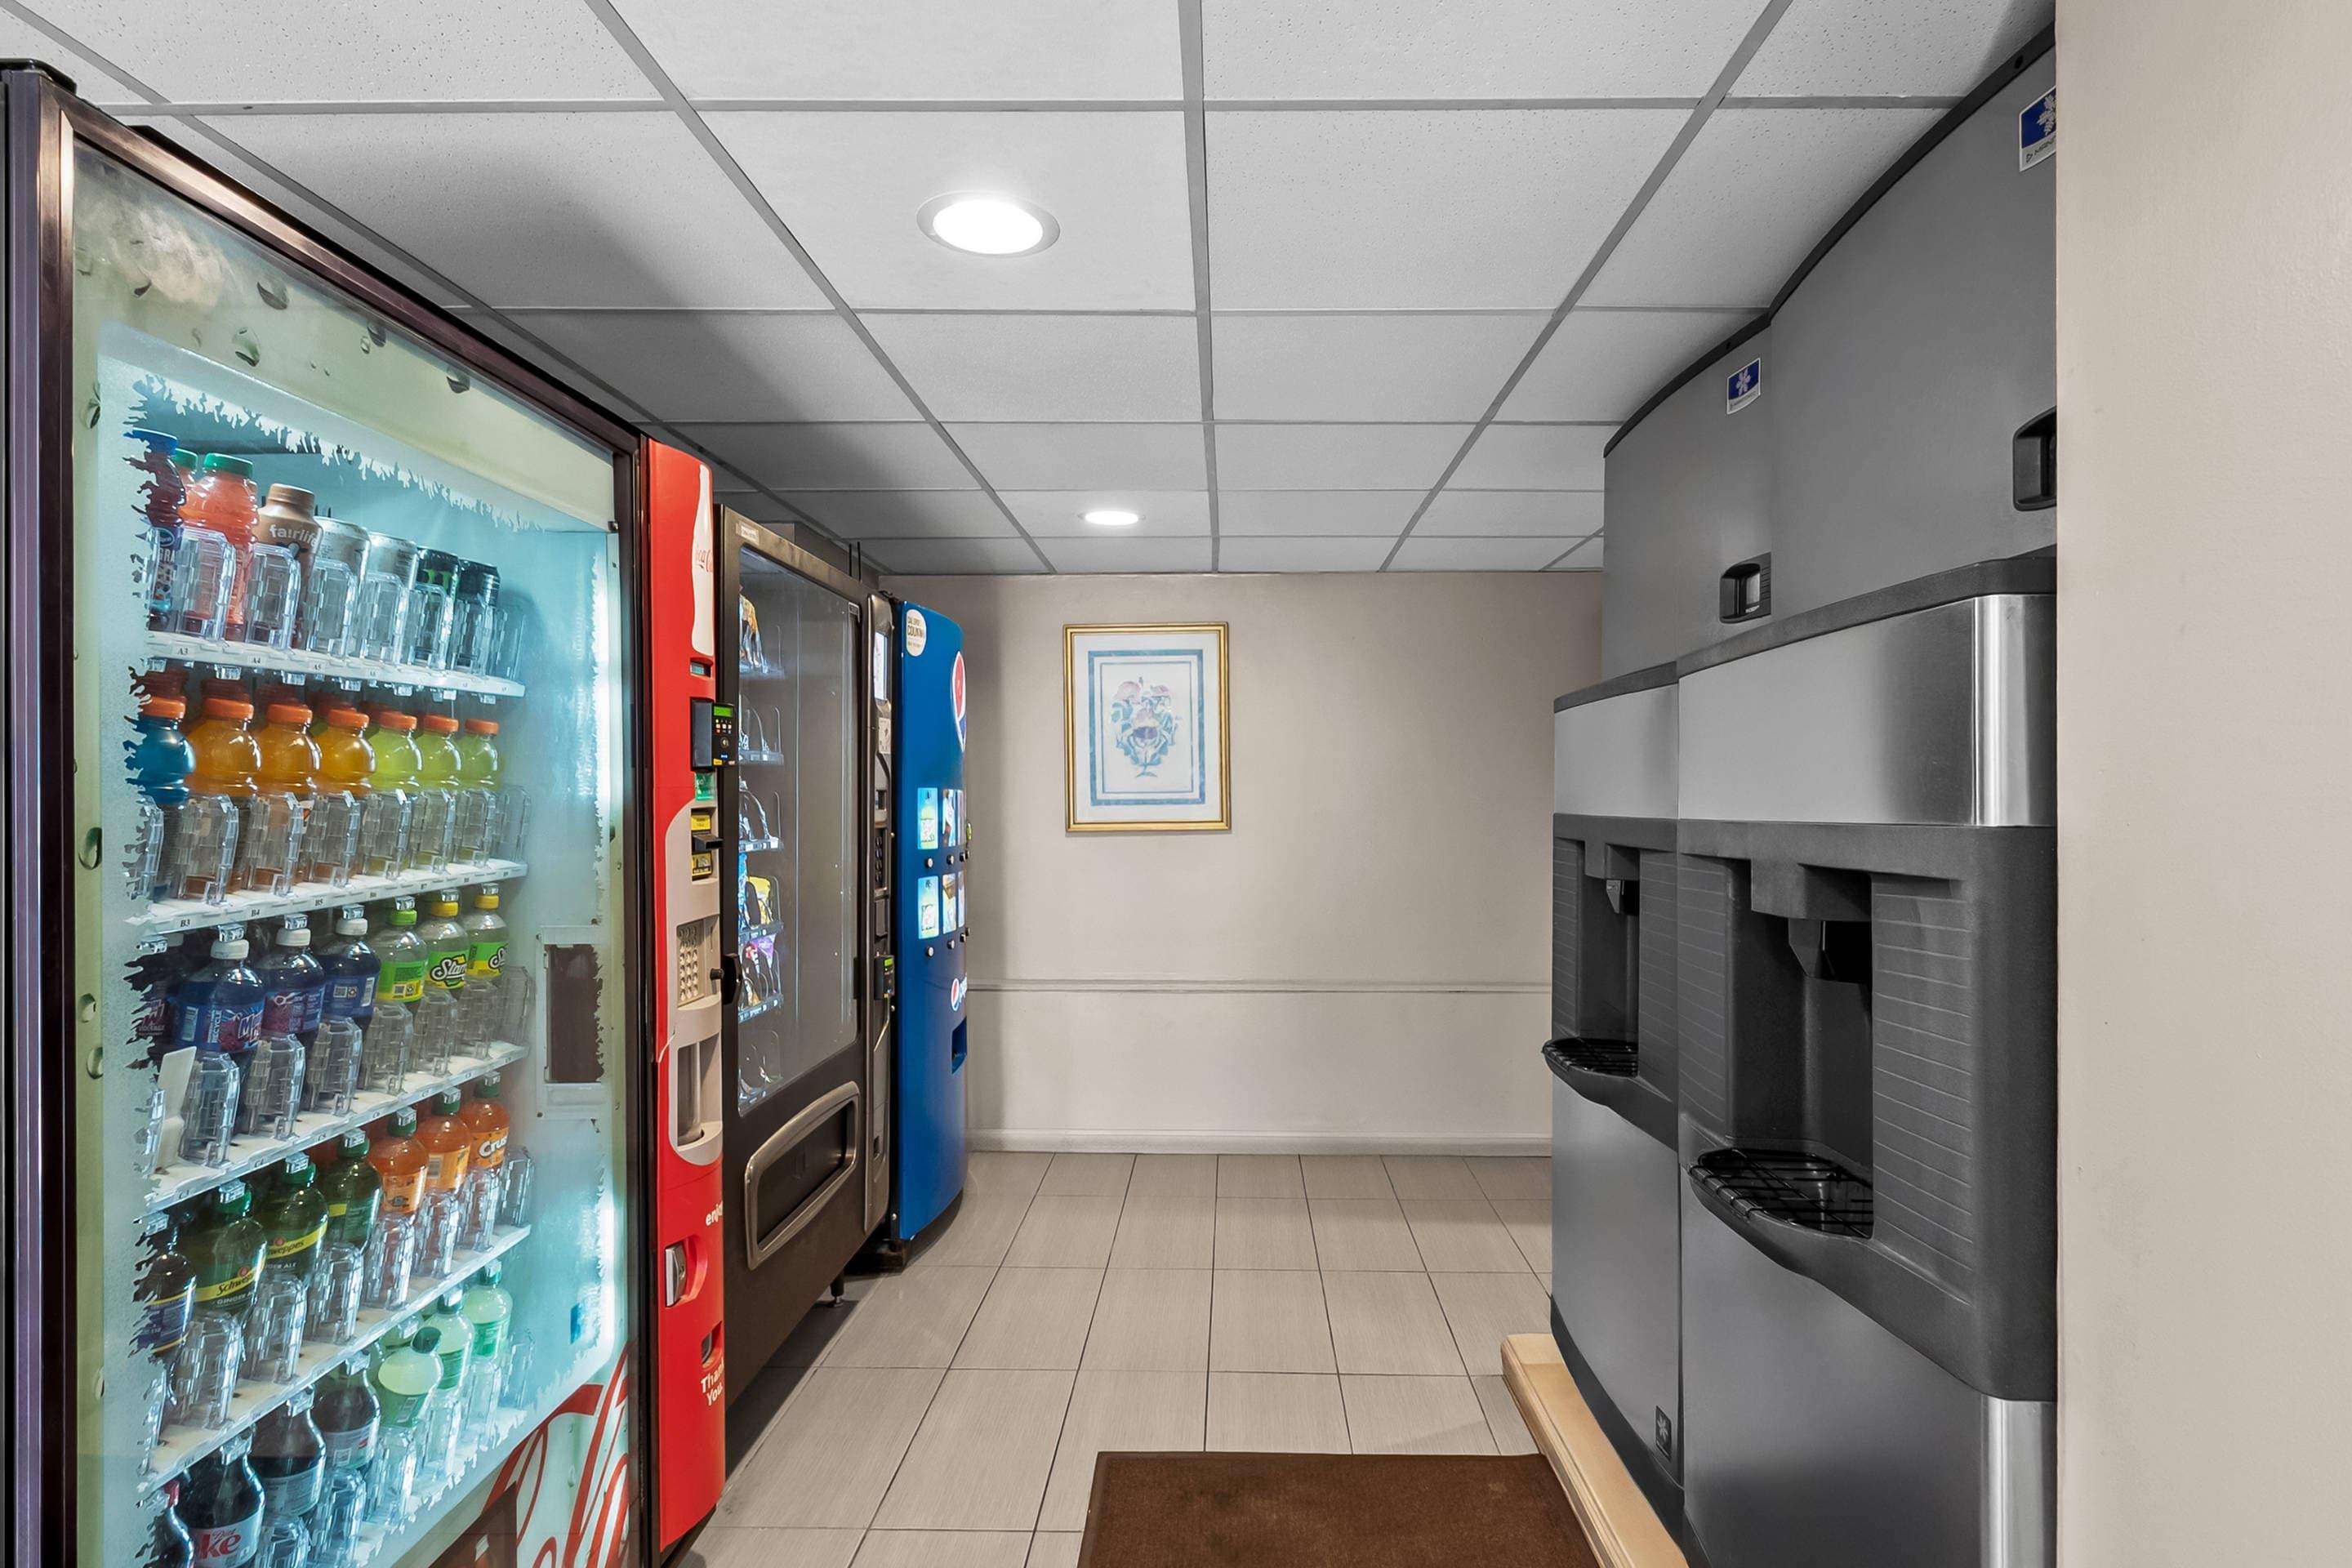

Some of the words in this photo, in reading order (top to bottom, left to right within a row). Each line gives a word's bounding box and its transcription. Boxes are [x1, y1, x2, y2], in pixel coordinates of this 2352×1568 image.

[177, 647, 189, 655] A3
[314, 898, 323, 906] B5
[251, 909, 261, 918] B4
[180, 919, 190, 928] B3
[479, 1135, 508, 1157] Crus
